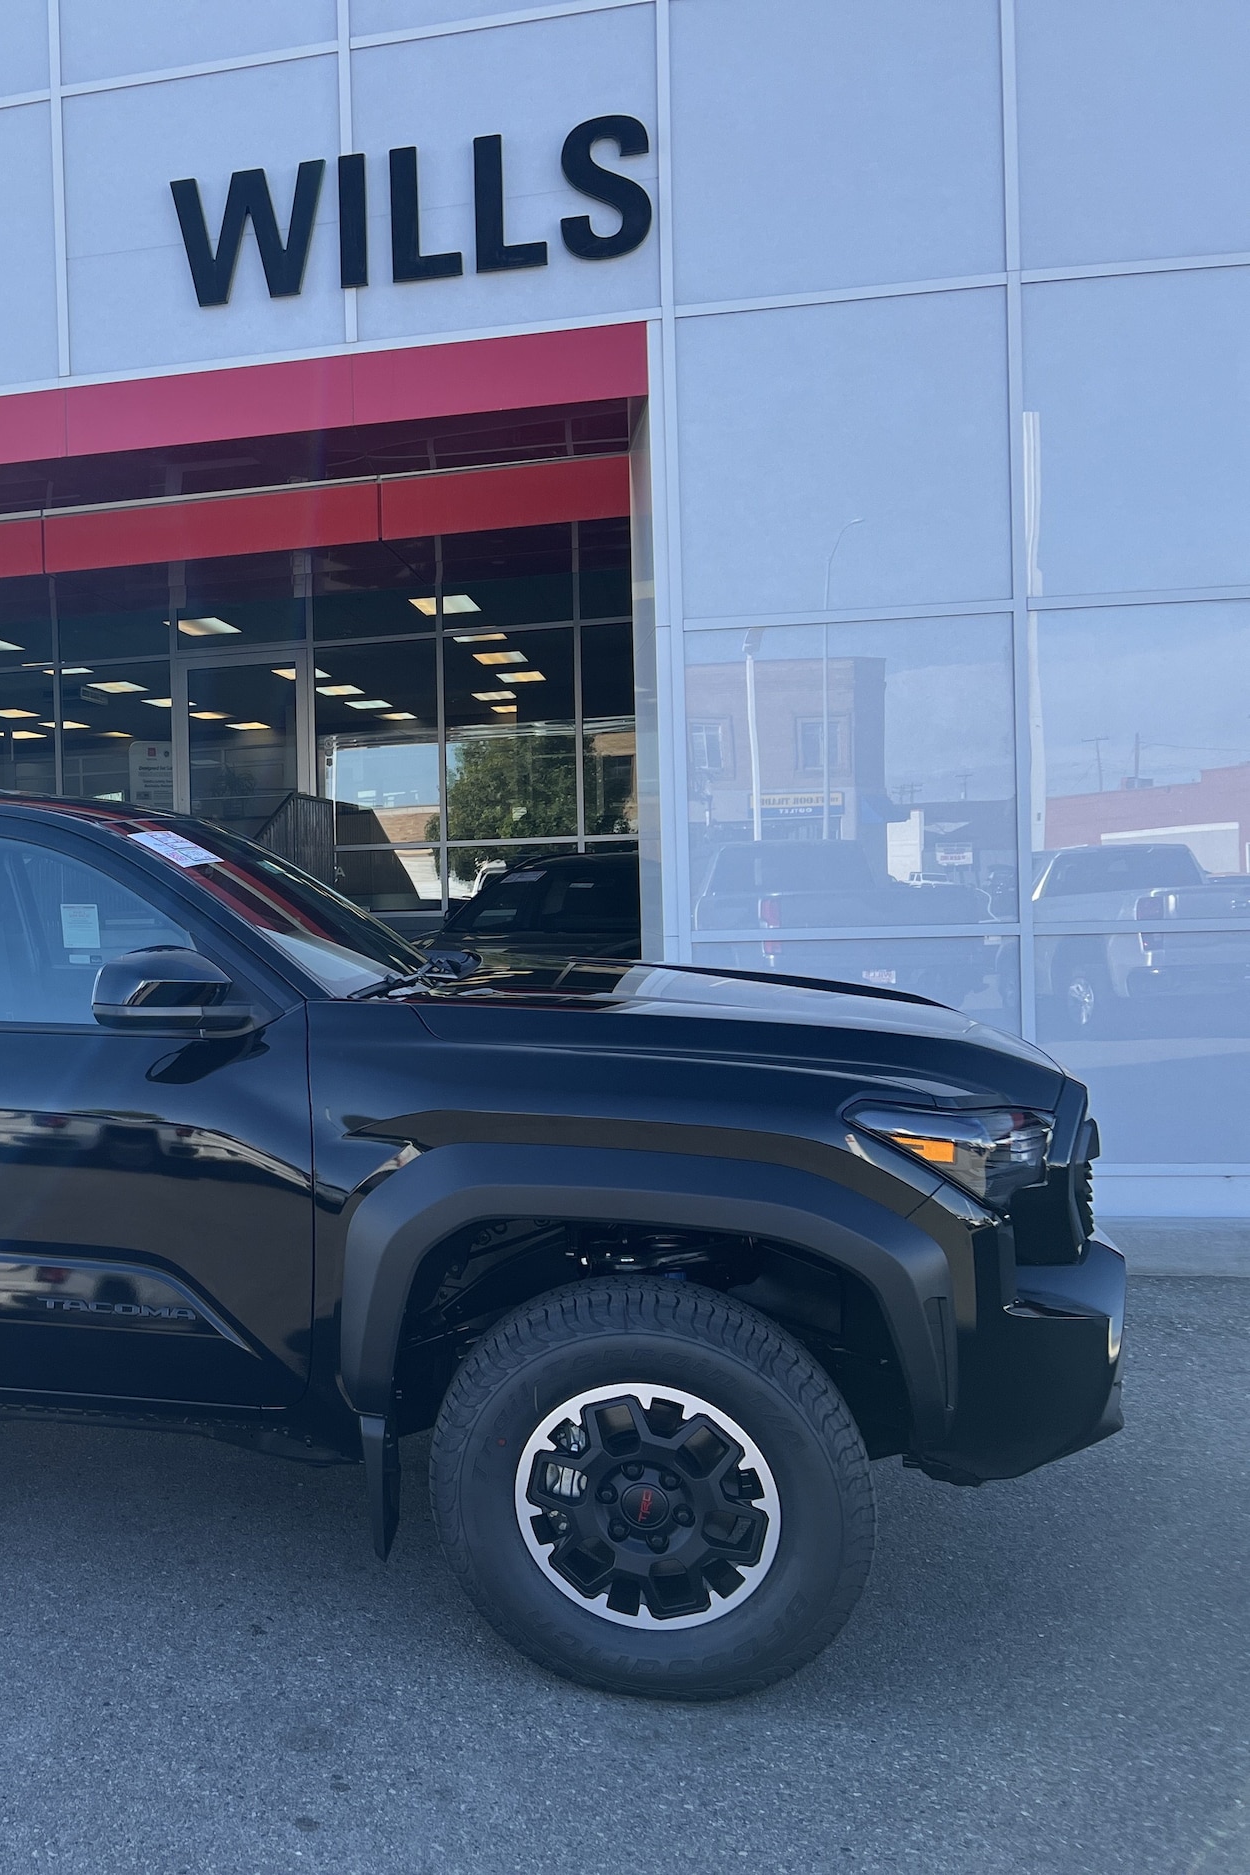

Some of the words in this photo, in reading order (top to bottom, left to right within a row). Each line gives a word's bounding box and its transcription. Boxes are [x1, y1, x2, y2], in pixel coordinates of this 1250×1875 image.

[169, 113, 653, 308] WILLS
[36, 1296, 198, 1321] TACOMA
[638, 1490, 654, 1522] TRD
